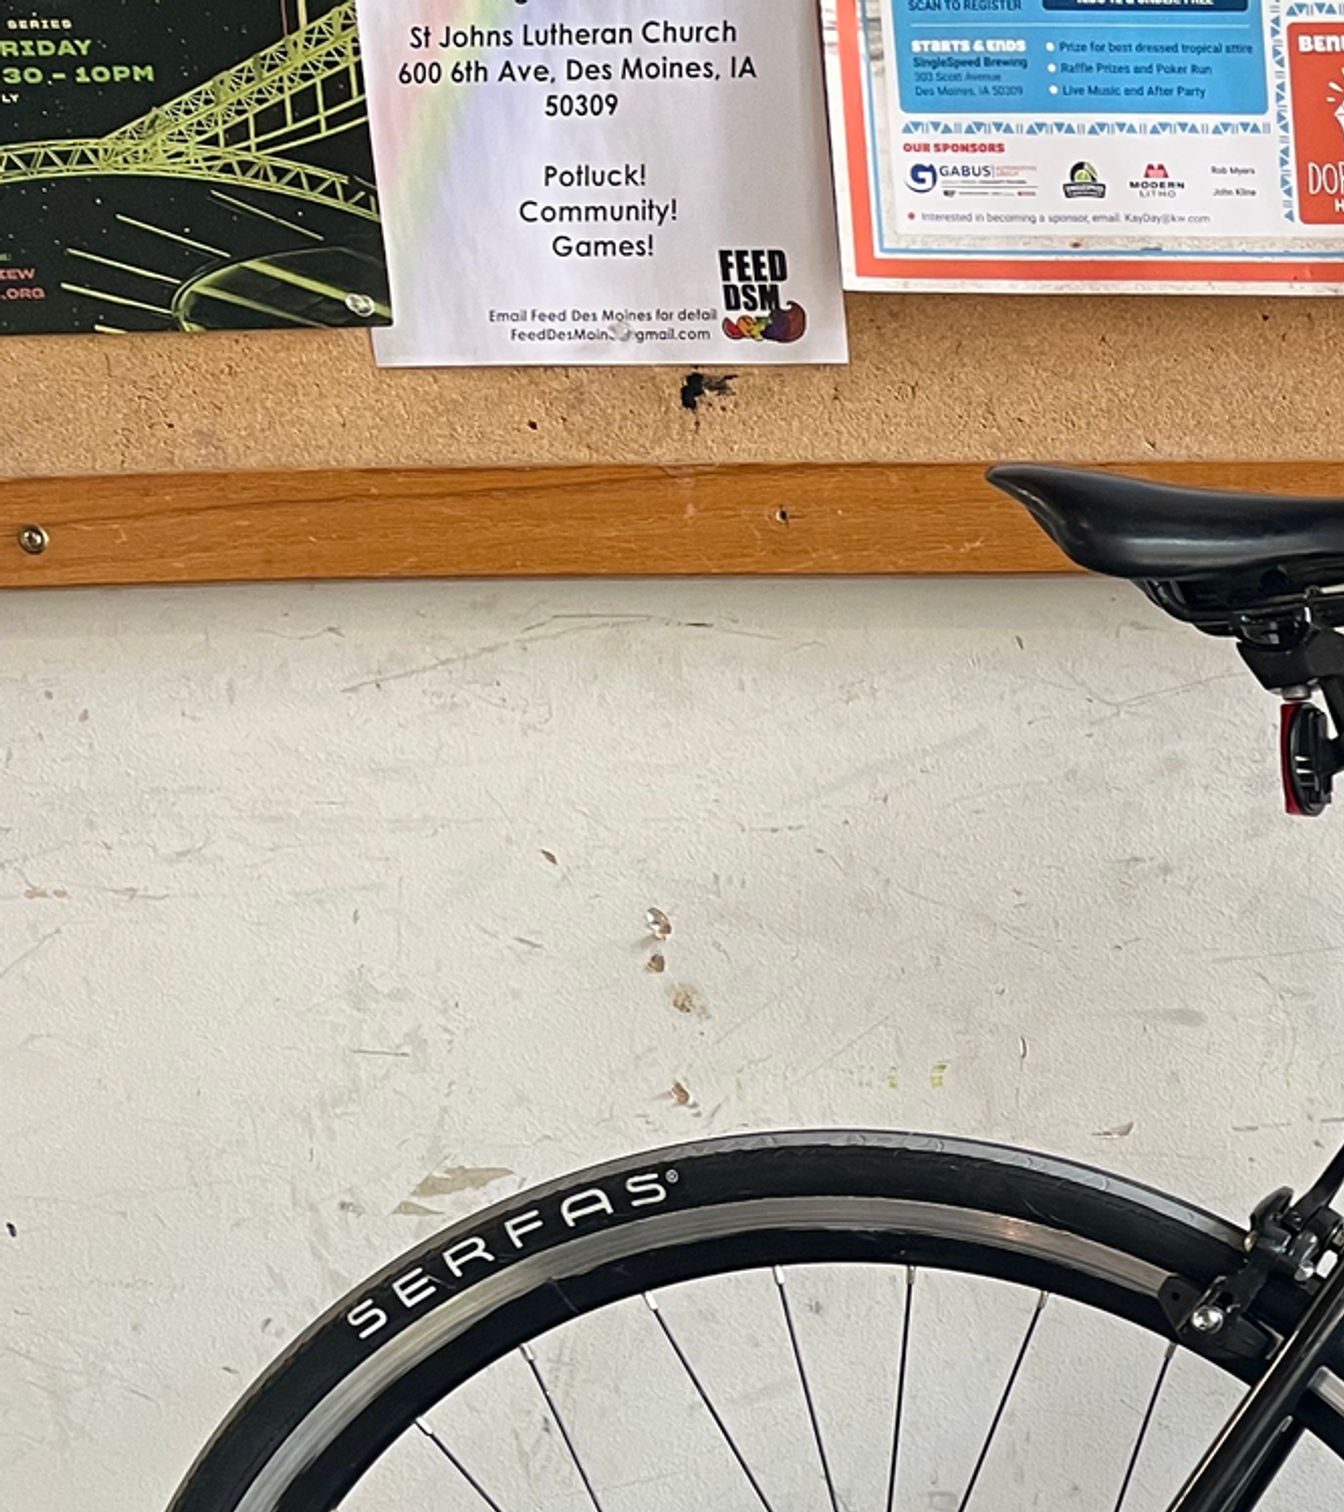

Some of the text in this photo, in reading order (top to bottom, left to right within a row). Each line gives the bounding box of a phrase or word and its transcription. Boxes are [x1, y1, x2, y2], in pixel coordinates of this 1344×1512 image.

[7, 18, 73, 30] SERIES
[409, 20, 738, 49] St Johns Lutheran Church
[911, 39, 1027, 52] STARTS & ENDS
[1059, 42, 1254, 56] Prize for best dressed tropical attire
[913, 56, 1029, 70] SingleSpeed Brewing
[1061, 63, 1213, 75] Raffle Prizes and Poker Run
[75, 65, 155, 83] 10PM
[398, 56, 758, 85] 600 6th Ave, Des Moines, IA
[915, 86, 935, 97] Des
[1062, 85, 1206, 99] Live Music and After Party
[544, 94, 619, 117] 50309
[903, 142, 1006, 154] OUR SPONSORS
[543, 164, 647, 188] Potluck!
[939, 164, 992, 178] GABUS
[1211, 165, 1227, 175] Rob
[1129, 181, 1185, 190] MODERN
[518, 198, 678, 227] Community!
[921, 211, 973, 223] Interested
[975, 212, 985, 223] in
[986, 212, 1036, 225] becoming
[552, 234, 655, 258] Games!
[717, 249, 789, 282] FEED
[722, 284, 783, 312] DSM
[488, 308, 718, 323] Email Feed Des Moines for detail
